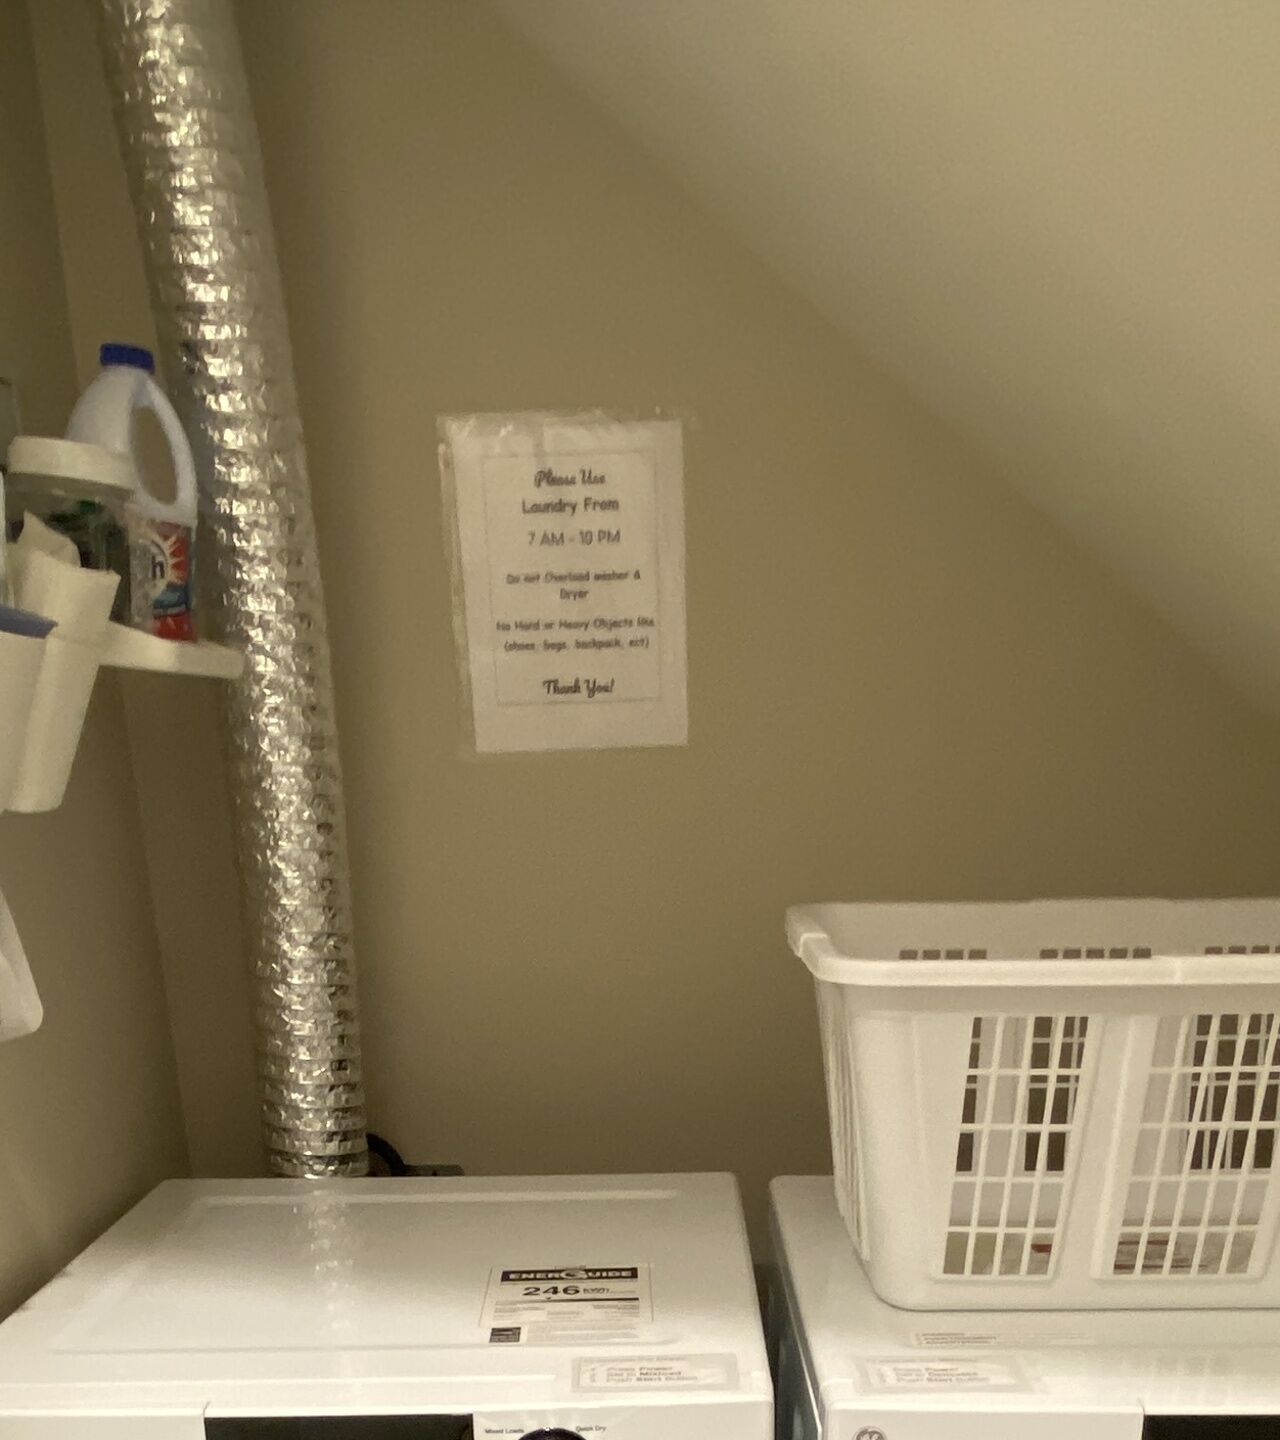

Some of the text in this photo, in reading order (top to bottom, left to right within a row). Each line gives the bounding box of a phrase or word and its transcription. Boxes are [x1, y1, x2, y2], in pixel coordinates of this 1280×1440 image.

[534, 467, 606, 488] Please Use
[521, 497, 619, 516] Laundry From
[528, 531, 536, 545] 7
[540, 531, 565, 546] AM
[580, 530, 593, 546] 10
[598, 529, 621, 544] PM
[545, 571, 590, 584] Overload
[560, 588, 589, 600] Dryer
[515, 619, 540, 630] Hard
[559, 618, 590, 631] Heavy
[542, 677, 616, 699] Thank You!
[522, 1285, 581, 1297] 246
